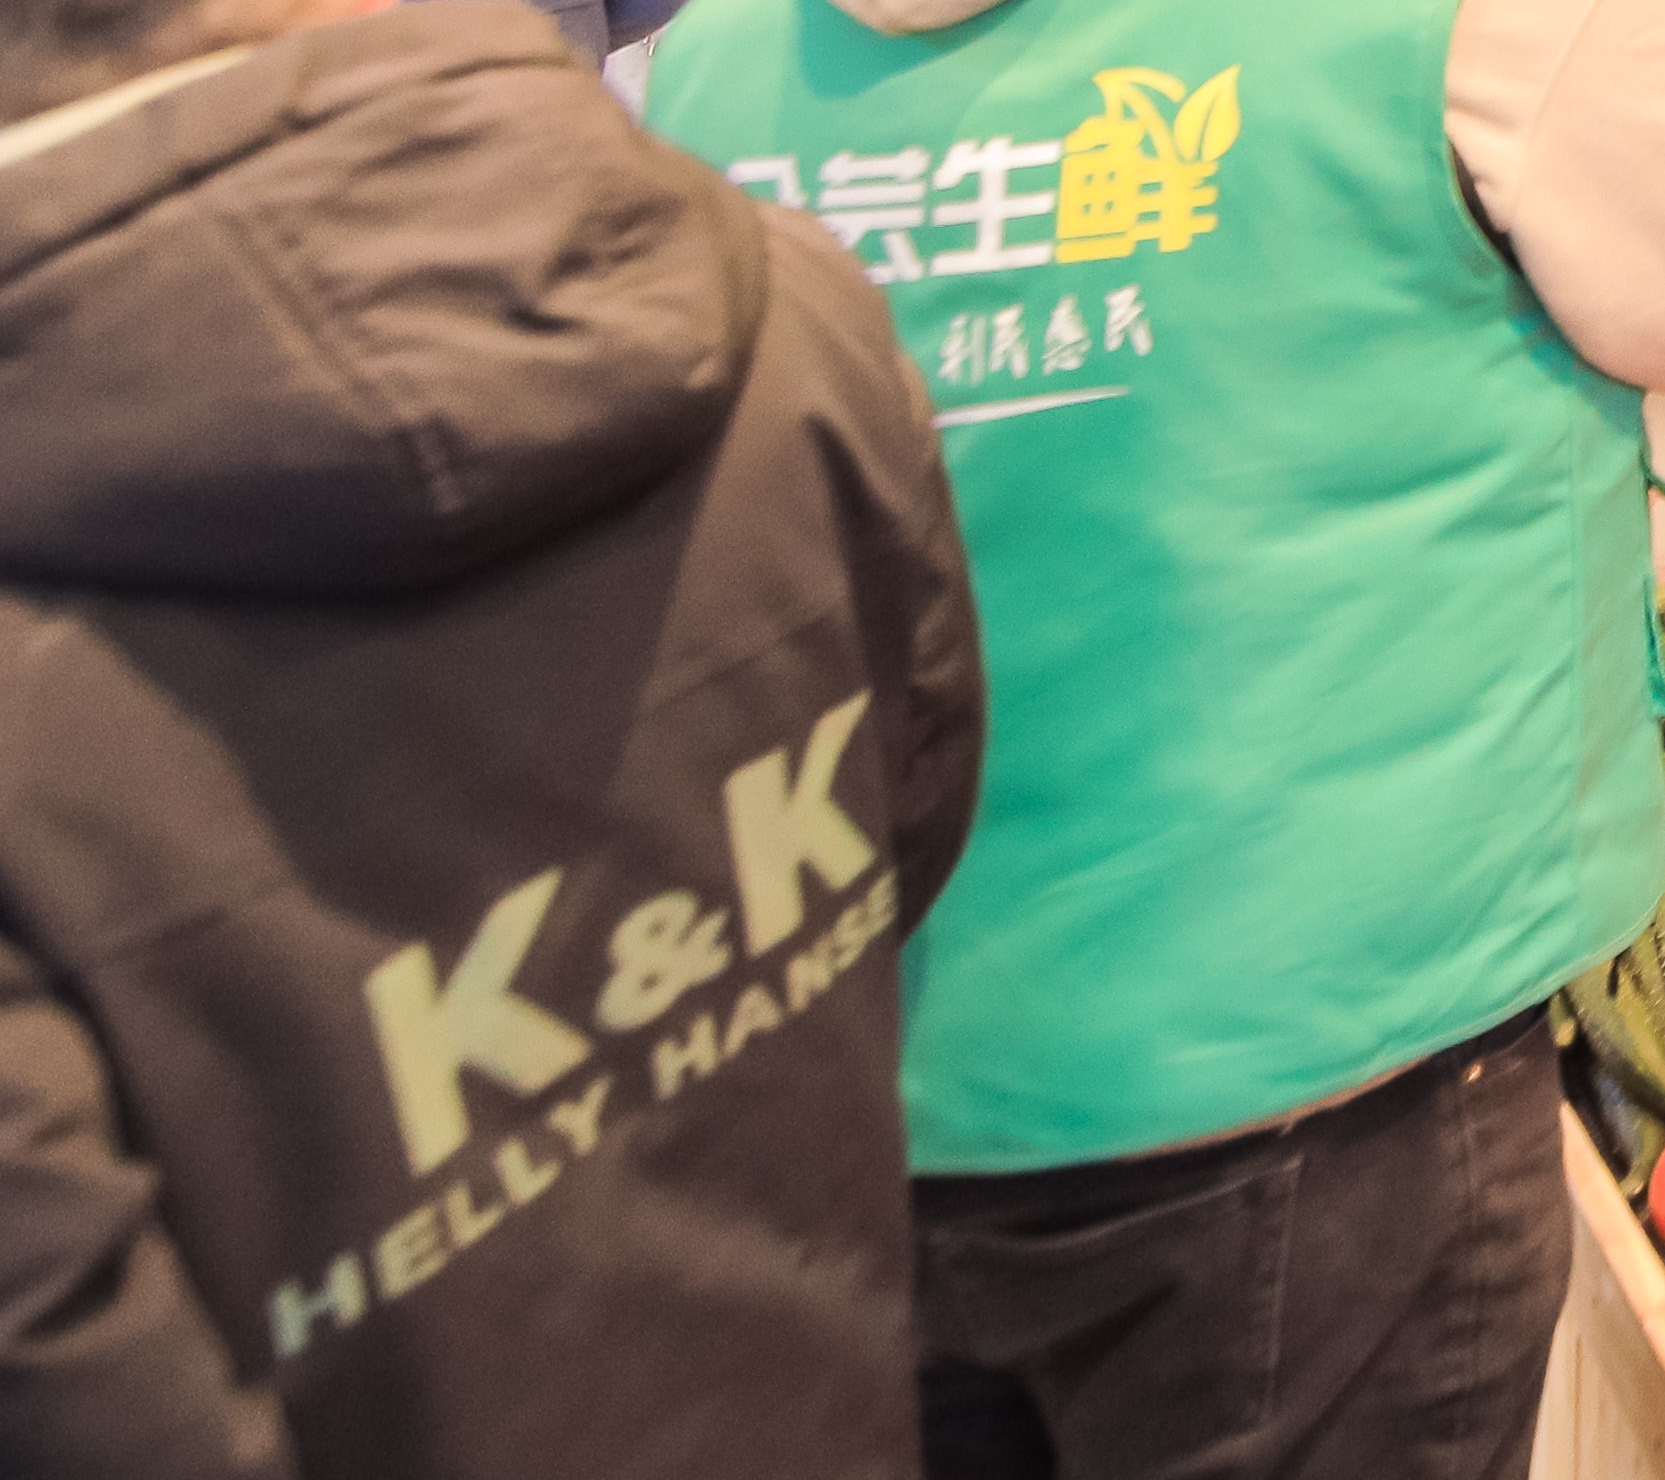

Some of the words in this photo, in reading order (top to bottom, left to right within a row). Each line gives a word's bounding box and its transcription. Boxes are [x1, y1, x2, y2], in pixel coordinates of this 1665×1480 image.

[725, 84, 1226, 285] 芸生鲜
[268, 1072, 613, 1361] HELLY
